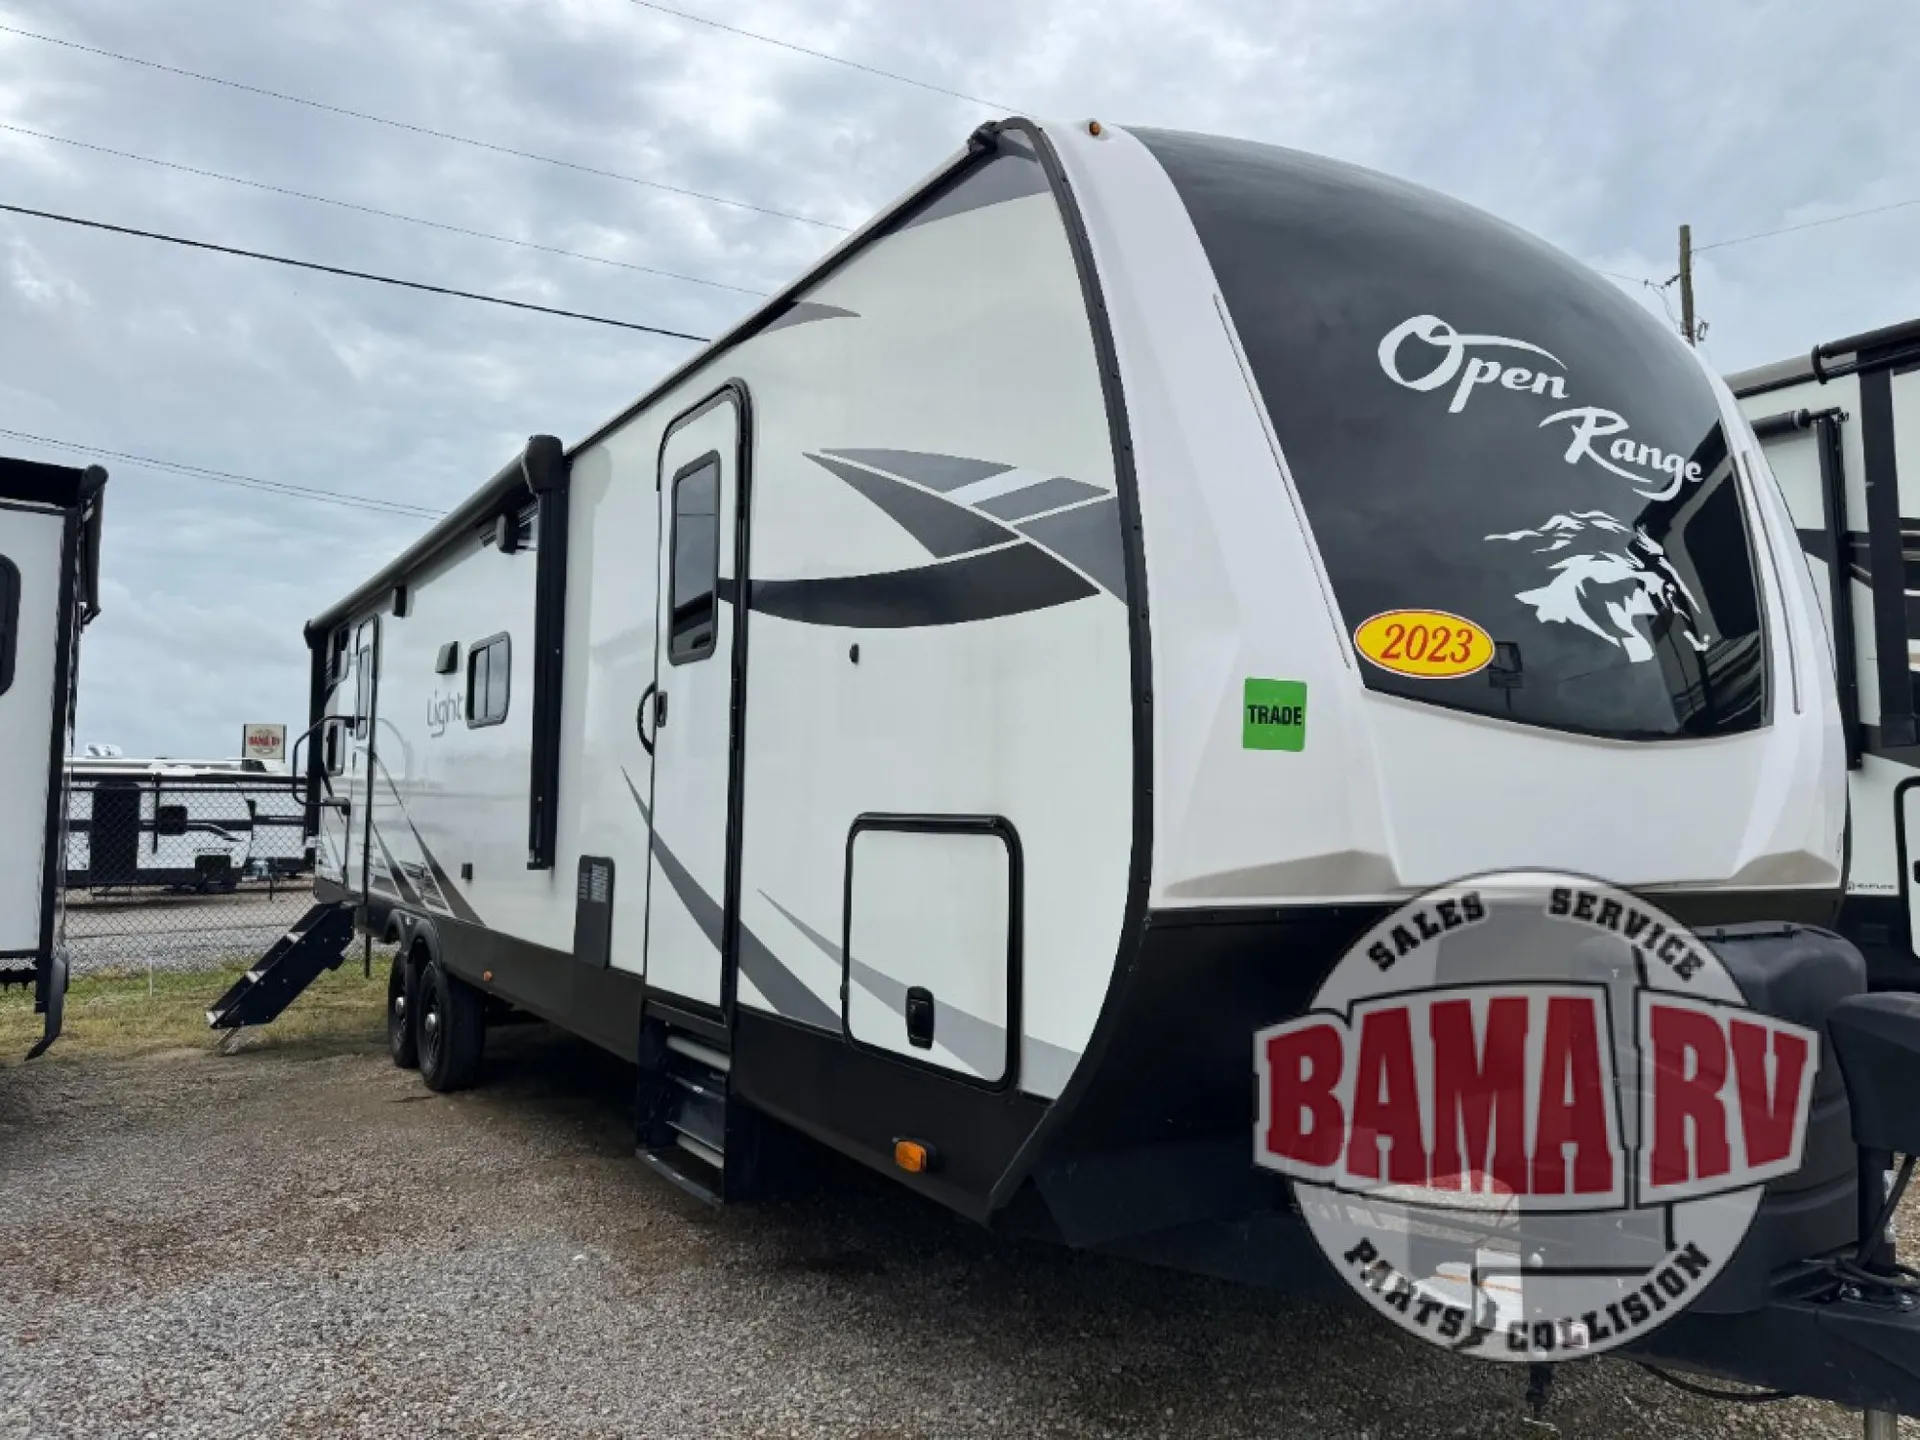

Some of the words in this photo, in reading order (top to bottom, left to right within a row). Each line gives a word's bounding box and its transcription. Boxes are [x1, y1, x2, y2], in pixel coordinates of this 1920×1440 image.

[1378, 314, 1570, 413] Open
[1539, 406, 1703, 500] Range
[1380, 624, 1473, 663] 2023
[427, 689, 463, 738] Light
[1248, 704, 1302, 726] TRADE
